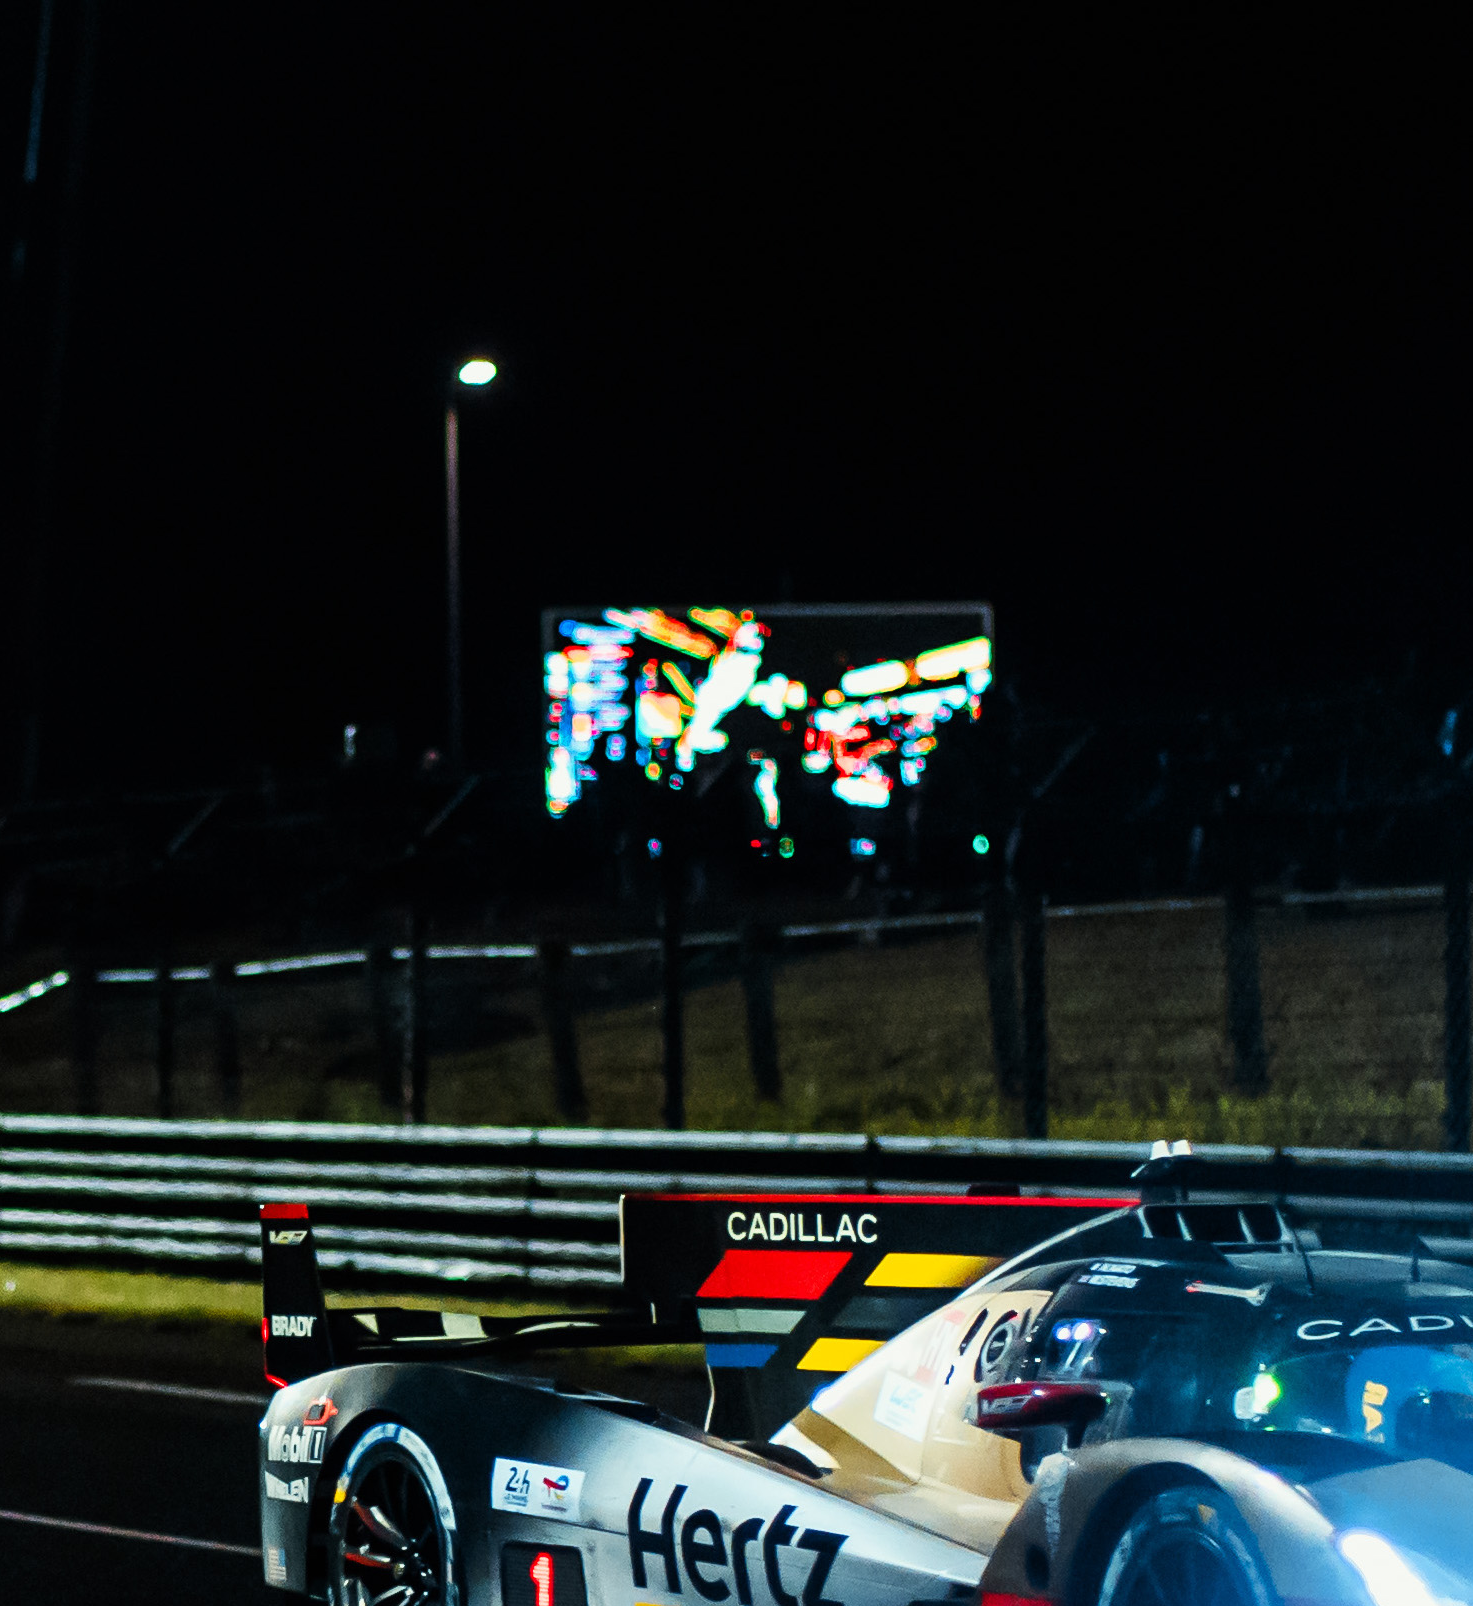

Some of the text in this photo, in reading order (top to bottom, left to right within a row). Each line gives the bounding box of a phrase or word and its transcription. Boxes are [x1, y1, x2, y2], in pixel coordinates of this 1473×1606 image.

[727, 1211, 878, 1243] CADILLAC
[271, 1315, 314, 1337] BRADY
[267, 1425, 311, 1463] Mobil
